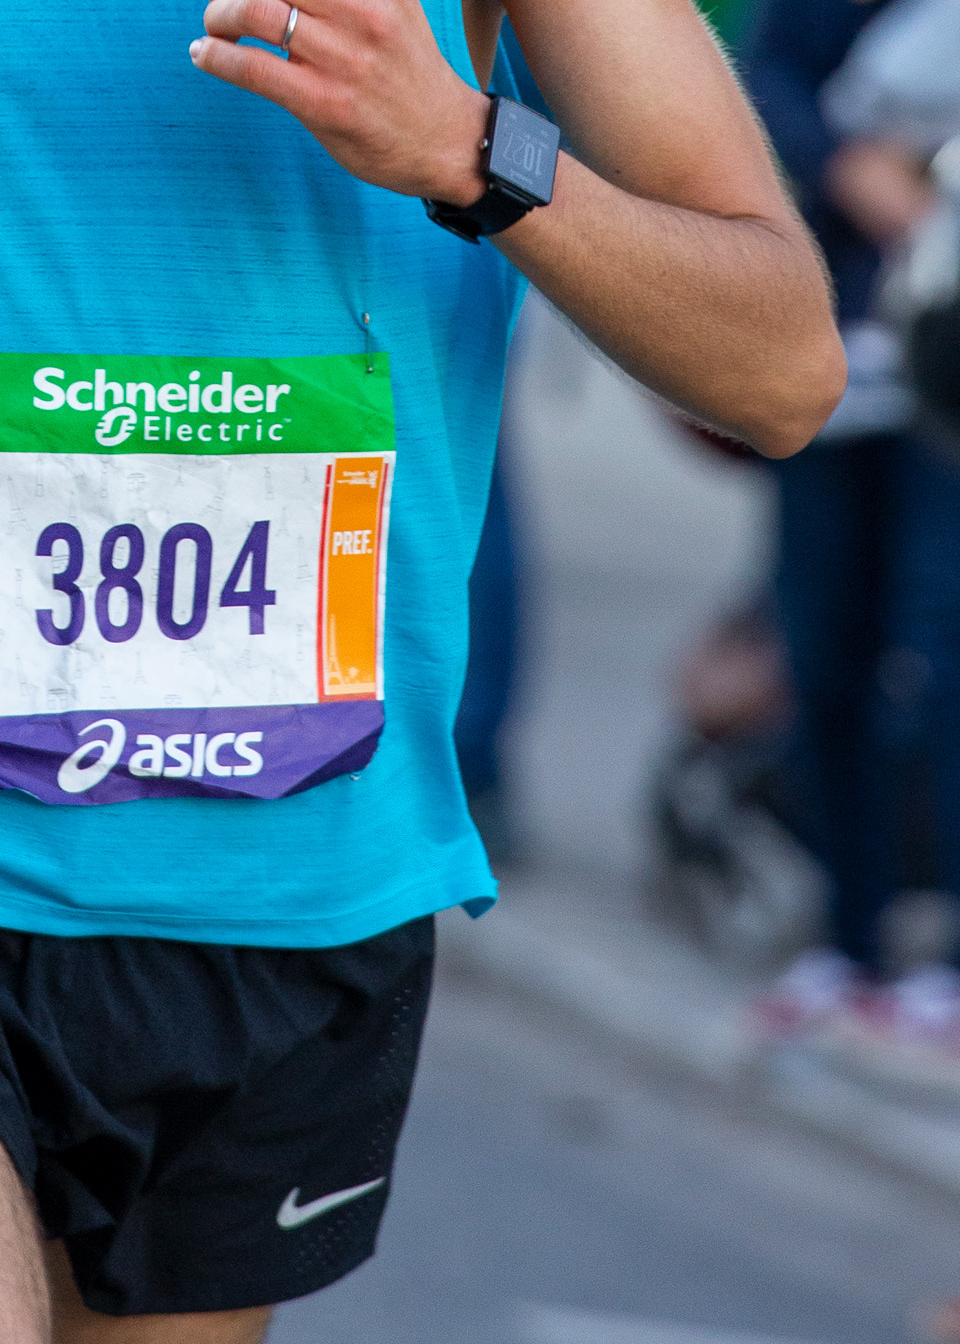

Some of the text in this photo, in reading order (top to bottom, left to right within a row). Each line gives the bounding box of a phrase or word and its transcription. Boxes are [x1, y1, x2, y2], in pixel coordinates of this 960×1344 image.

[33, 366, 291, 414] Schneider
[144, 416, 284, 442] Electric
[332, 530, 373, 556] PREF.
[35, 519, 277, 647] 3804
